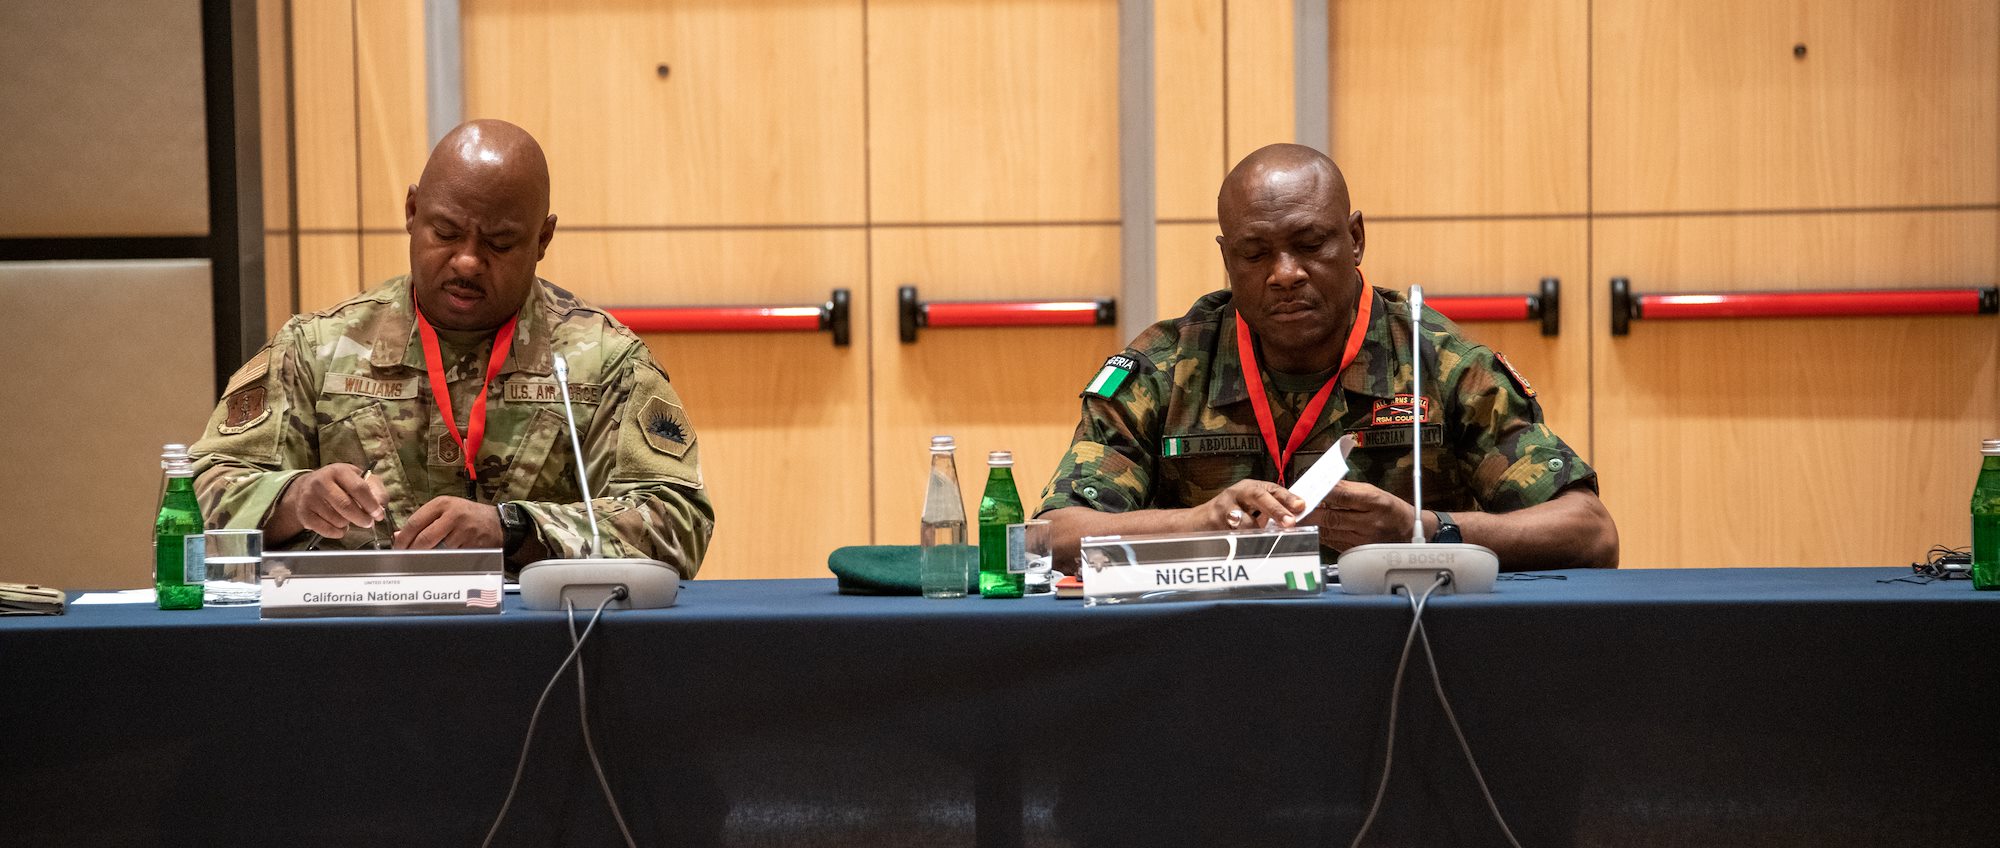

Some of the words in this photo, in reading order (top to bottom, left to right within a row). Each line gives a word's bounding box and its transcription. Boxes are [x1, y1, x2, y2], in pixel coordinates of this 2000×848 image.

[344, 377, 402, 397] WILLIAMS
[510, 384, 532, 400] U.S.
[536, 384, 556, 400] AIR
[560, 386, 599, 402] ORCE
[1410, 397, 1427, 407] DLL
[1183, 440, 1190, 453] B
[1199, 436, 1260, 452] ABDULLAHI
[1364, 430, 1405, 446] NIGERIAN
[1408, 552, 1455, 564] BOSCH
[1156, 564, 1250, 585] NIGERIA
[302, 591, 363, 603] California
[367, 590, 419, 601] National
[422, 590, 461, 600] Guard
